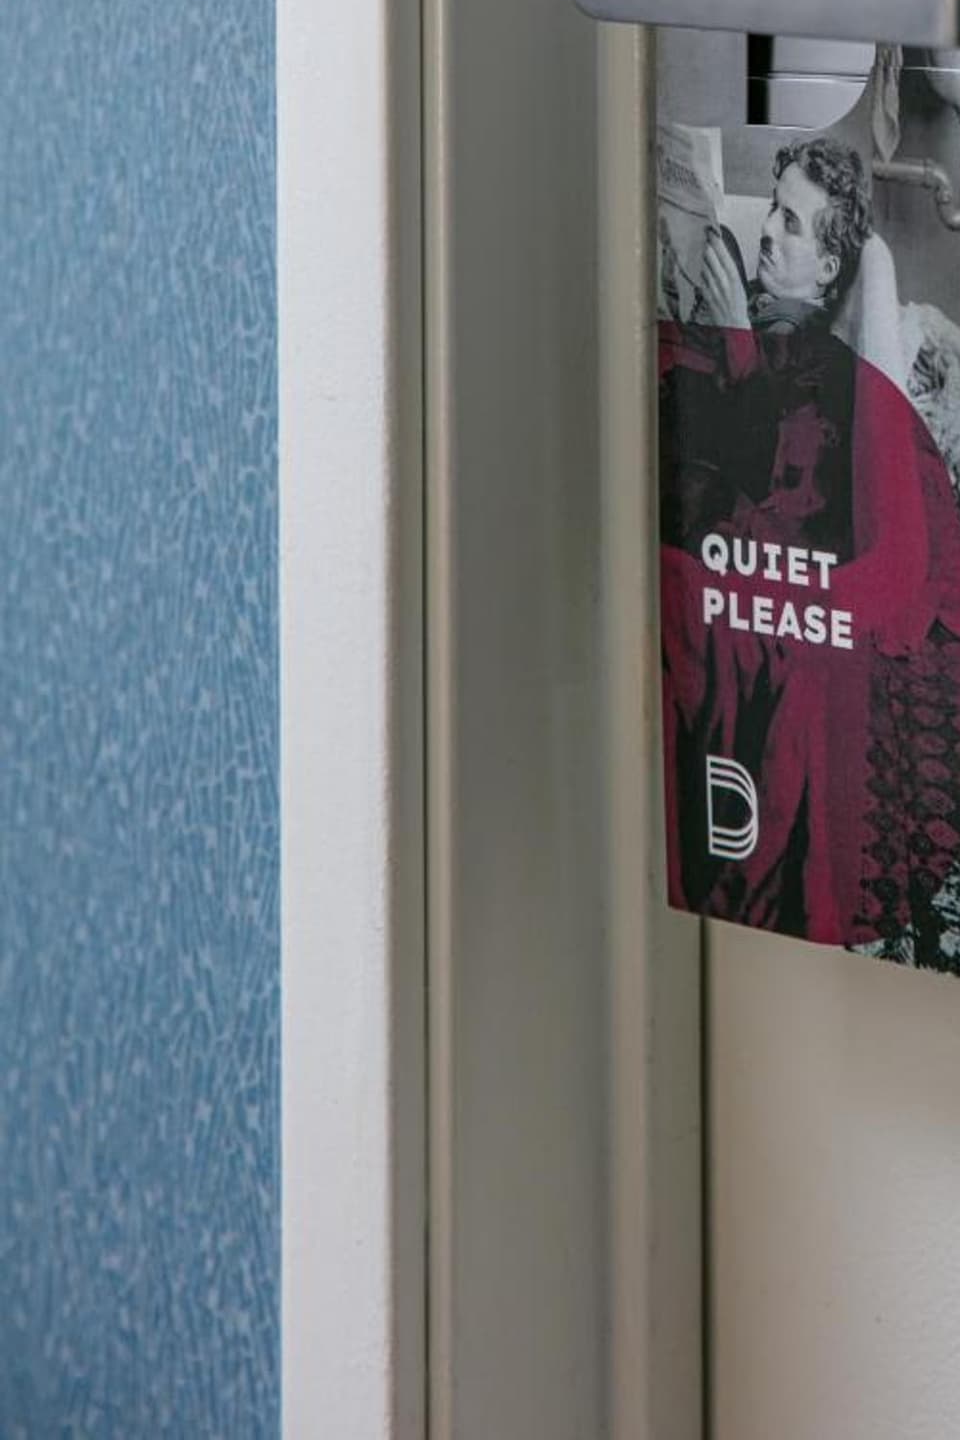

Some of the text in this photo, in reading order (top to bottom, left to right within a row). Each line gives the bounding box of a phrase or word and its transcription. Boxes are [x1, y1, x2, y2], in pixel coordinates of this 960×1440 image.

[702, 533, 838, 590] QUIET
[703, 587, 854, 650] PLEASE
[706, 755, 759, 860] D
